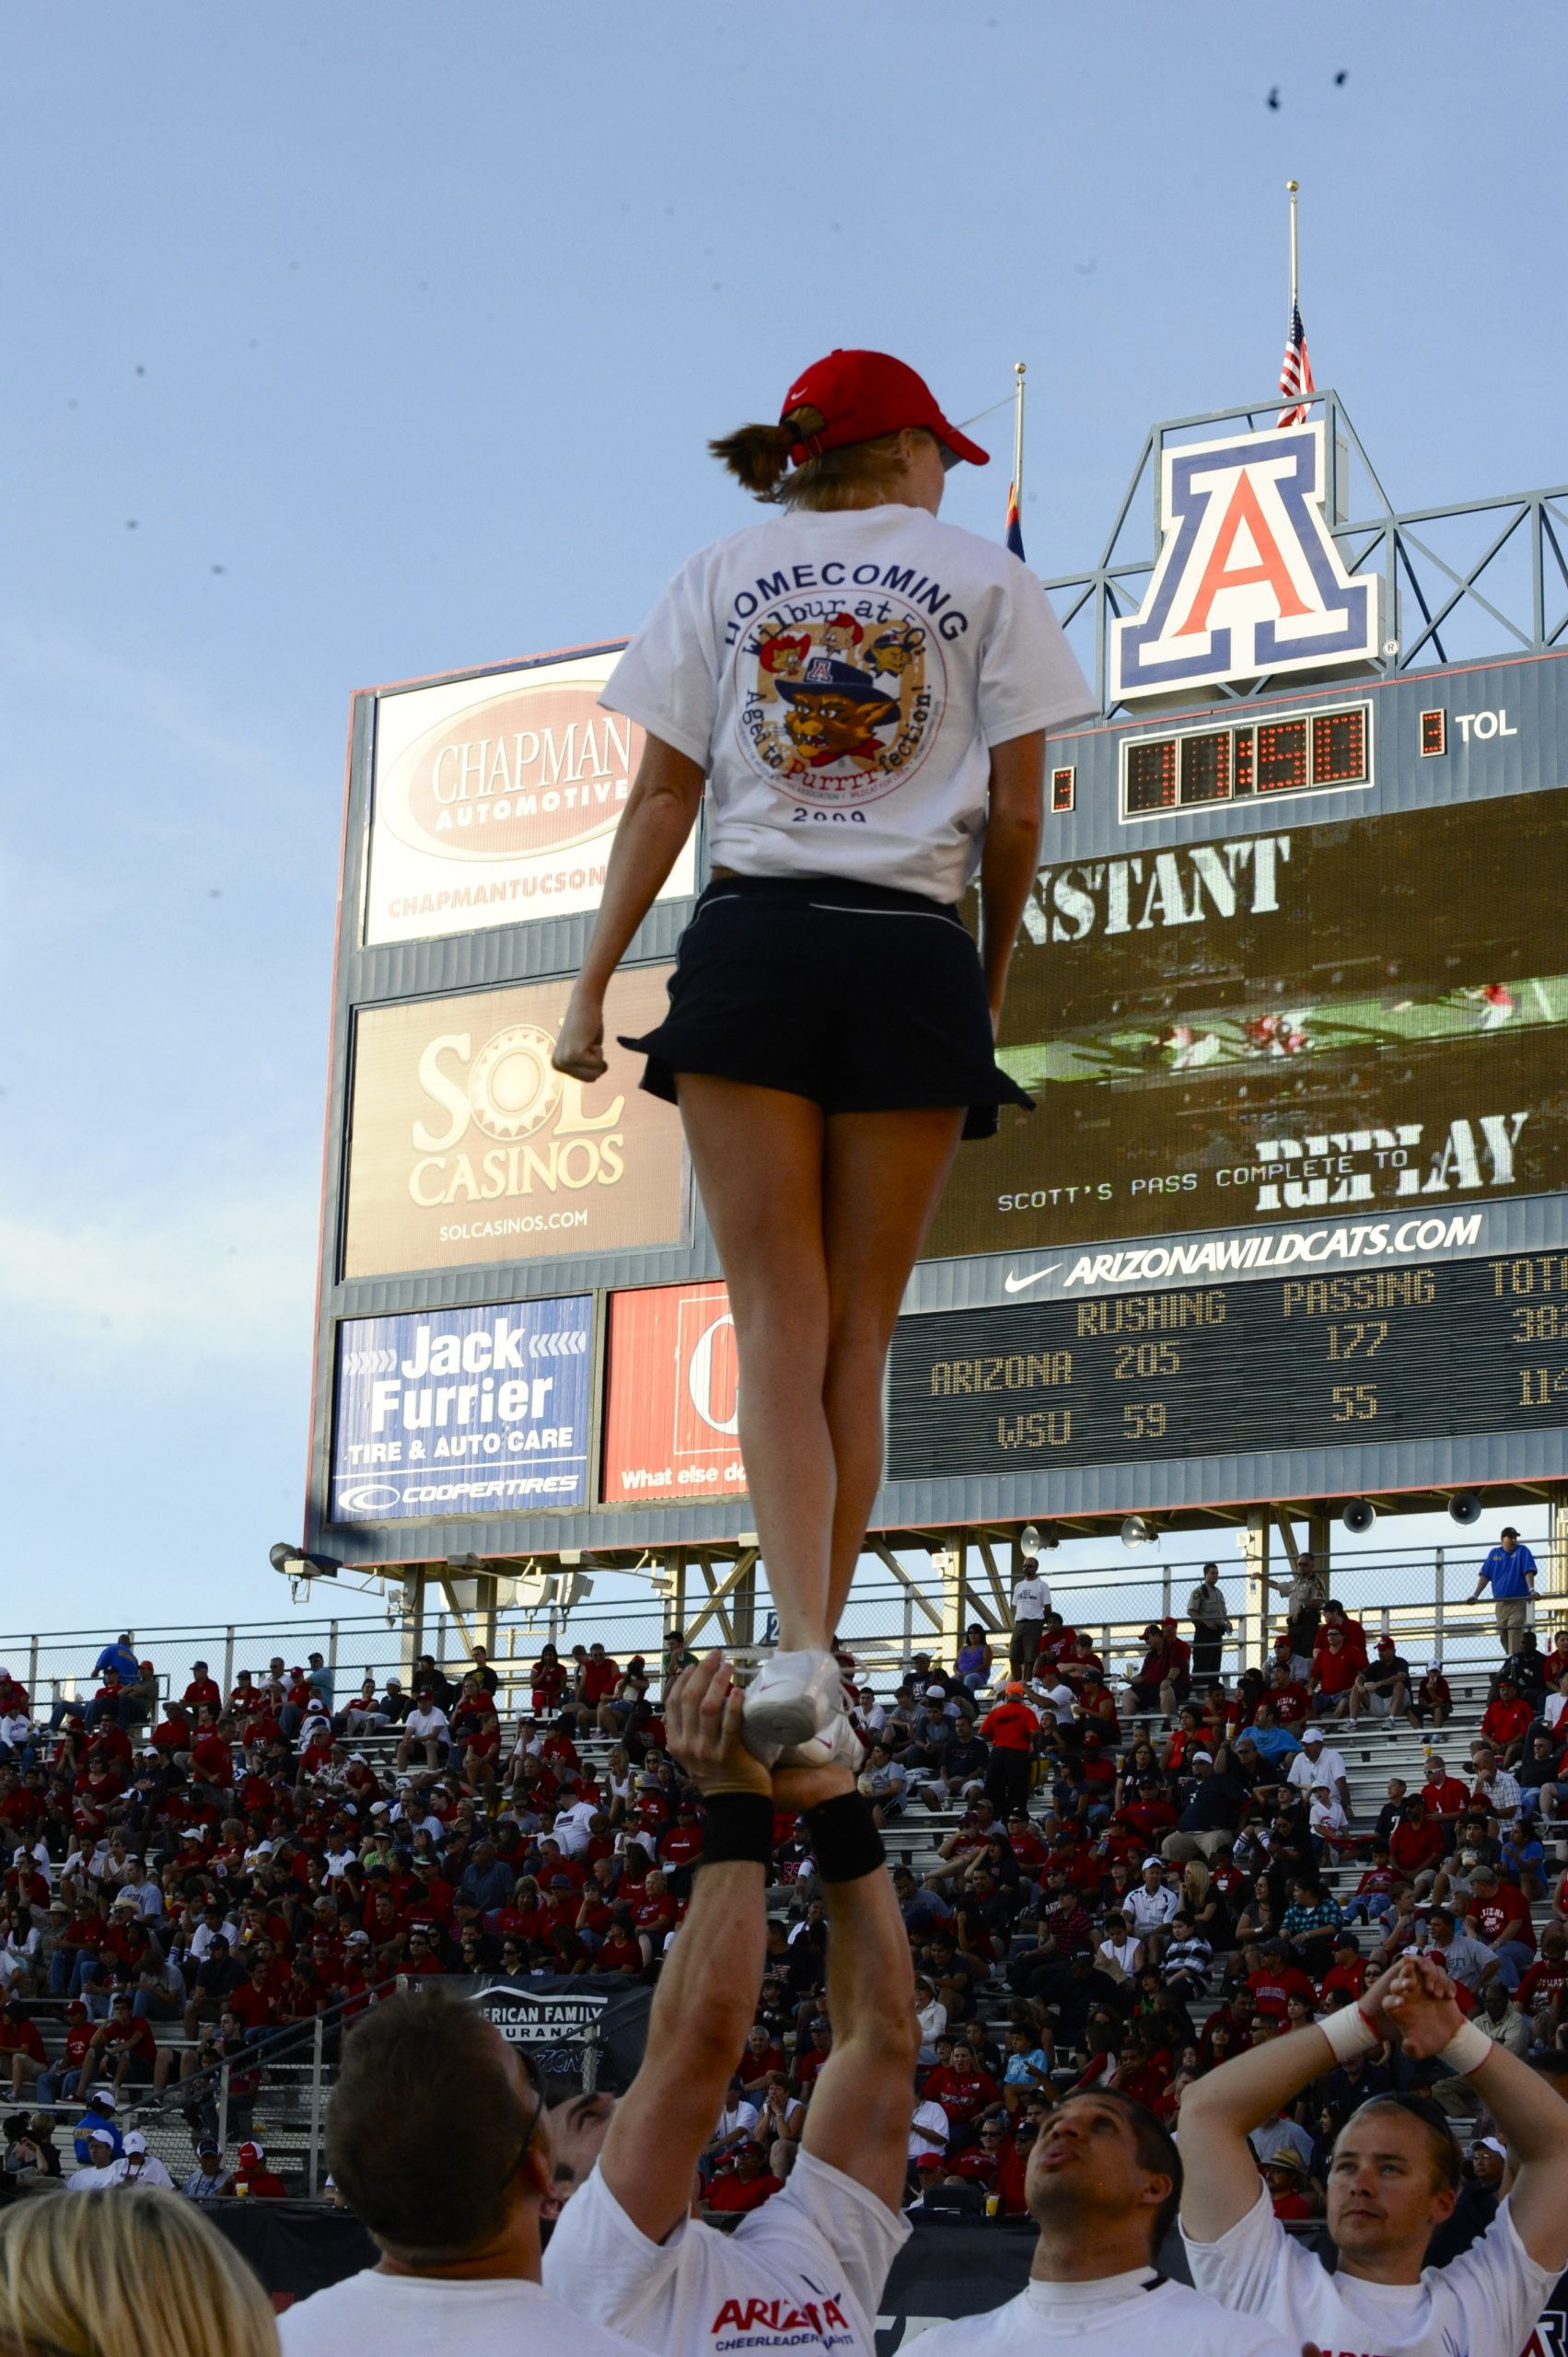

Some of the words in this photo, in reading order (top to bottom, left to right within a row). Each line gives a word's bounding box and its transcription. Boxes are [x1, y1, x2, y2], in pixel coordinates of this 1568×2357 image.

[1111, 420, 1377, 701] A
[725, 563, 968, 646] HOMECOMING
[742, 599, 845, 656] Wilbur
[854, 600, 891, 623] at
[742, 689, 771, 747] Aged
[761, 744, 784, 769] to
[1455, 710, 1517, 743] TOL
[432, 715, 632, 806] CHAPMAN
[435, 778, 628, 830] AUTOMOTIVE
[976, 836, 1290, 954] NSTANT
[412, 1016, 624, 1152] SOL
[409, 1133, 623, 1207] CASINOS
[997, 1182, 1112, 1213] SCOTT'S
[1131, 1172, 1197, 1196] PASS
[1215, 1154, 1354, 1188] COMPLETE
[1375, 1149, 1408, 1170] TO
[439, 1209, 588, 1242] SOLCASINOS.COM
[1063, 1214, 1482, 1287] ARIZONAWILDCATS.COM
[1077, 1290, 1225, 1337] RUSHING
[1283, 1269, 1435, 1317] PASSING
[401, 1318, 524, 1379] Jack
[931, 1351, 1074, 1396] ARIZONA
[1115, 1341, 1180, 1379] 205
[1327, 1320, 1388, 1360] 177
[371, 1376, 552, 1433] Furrier
[997, 1410, 1072, 1449] WSU
[1123, 1402, 1167, 1439] 59
[1332, 1385, 1377, 1421] 55
[348, 1441, 401, 1465] TIRE
[409, 1440, 426, 1461] &
[436, 1430, 501, 1458] AUTO
[507, 1426, 573, 1451] CARE
[621, 1469, 672, 1490] What
[678, 1464, 718, 1484] else
[545, 2006, 603, 2024] FAMILY
